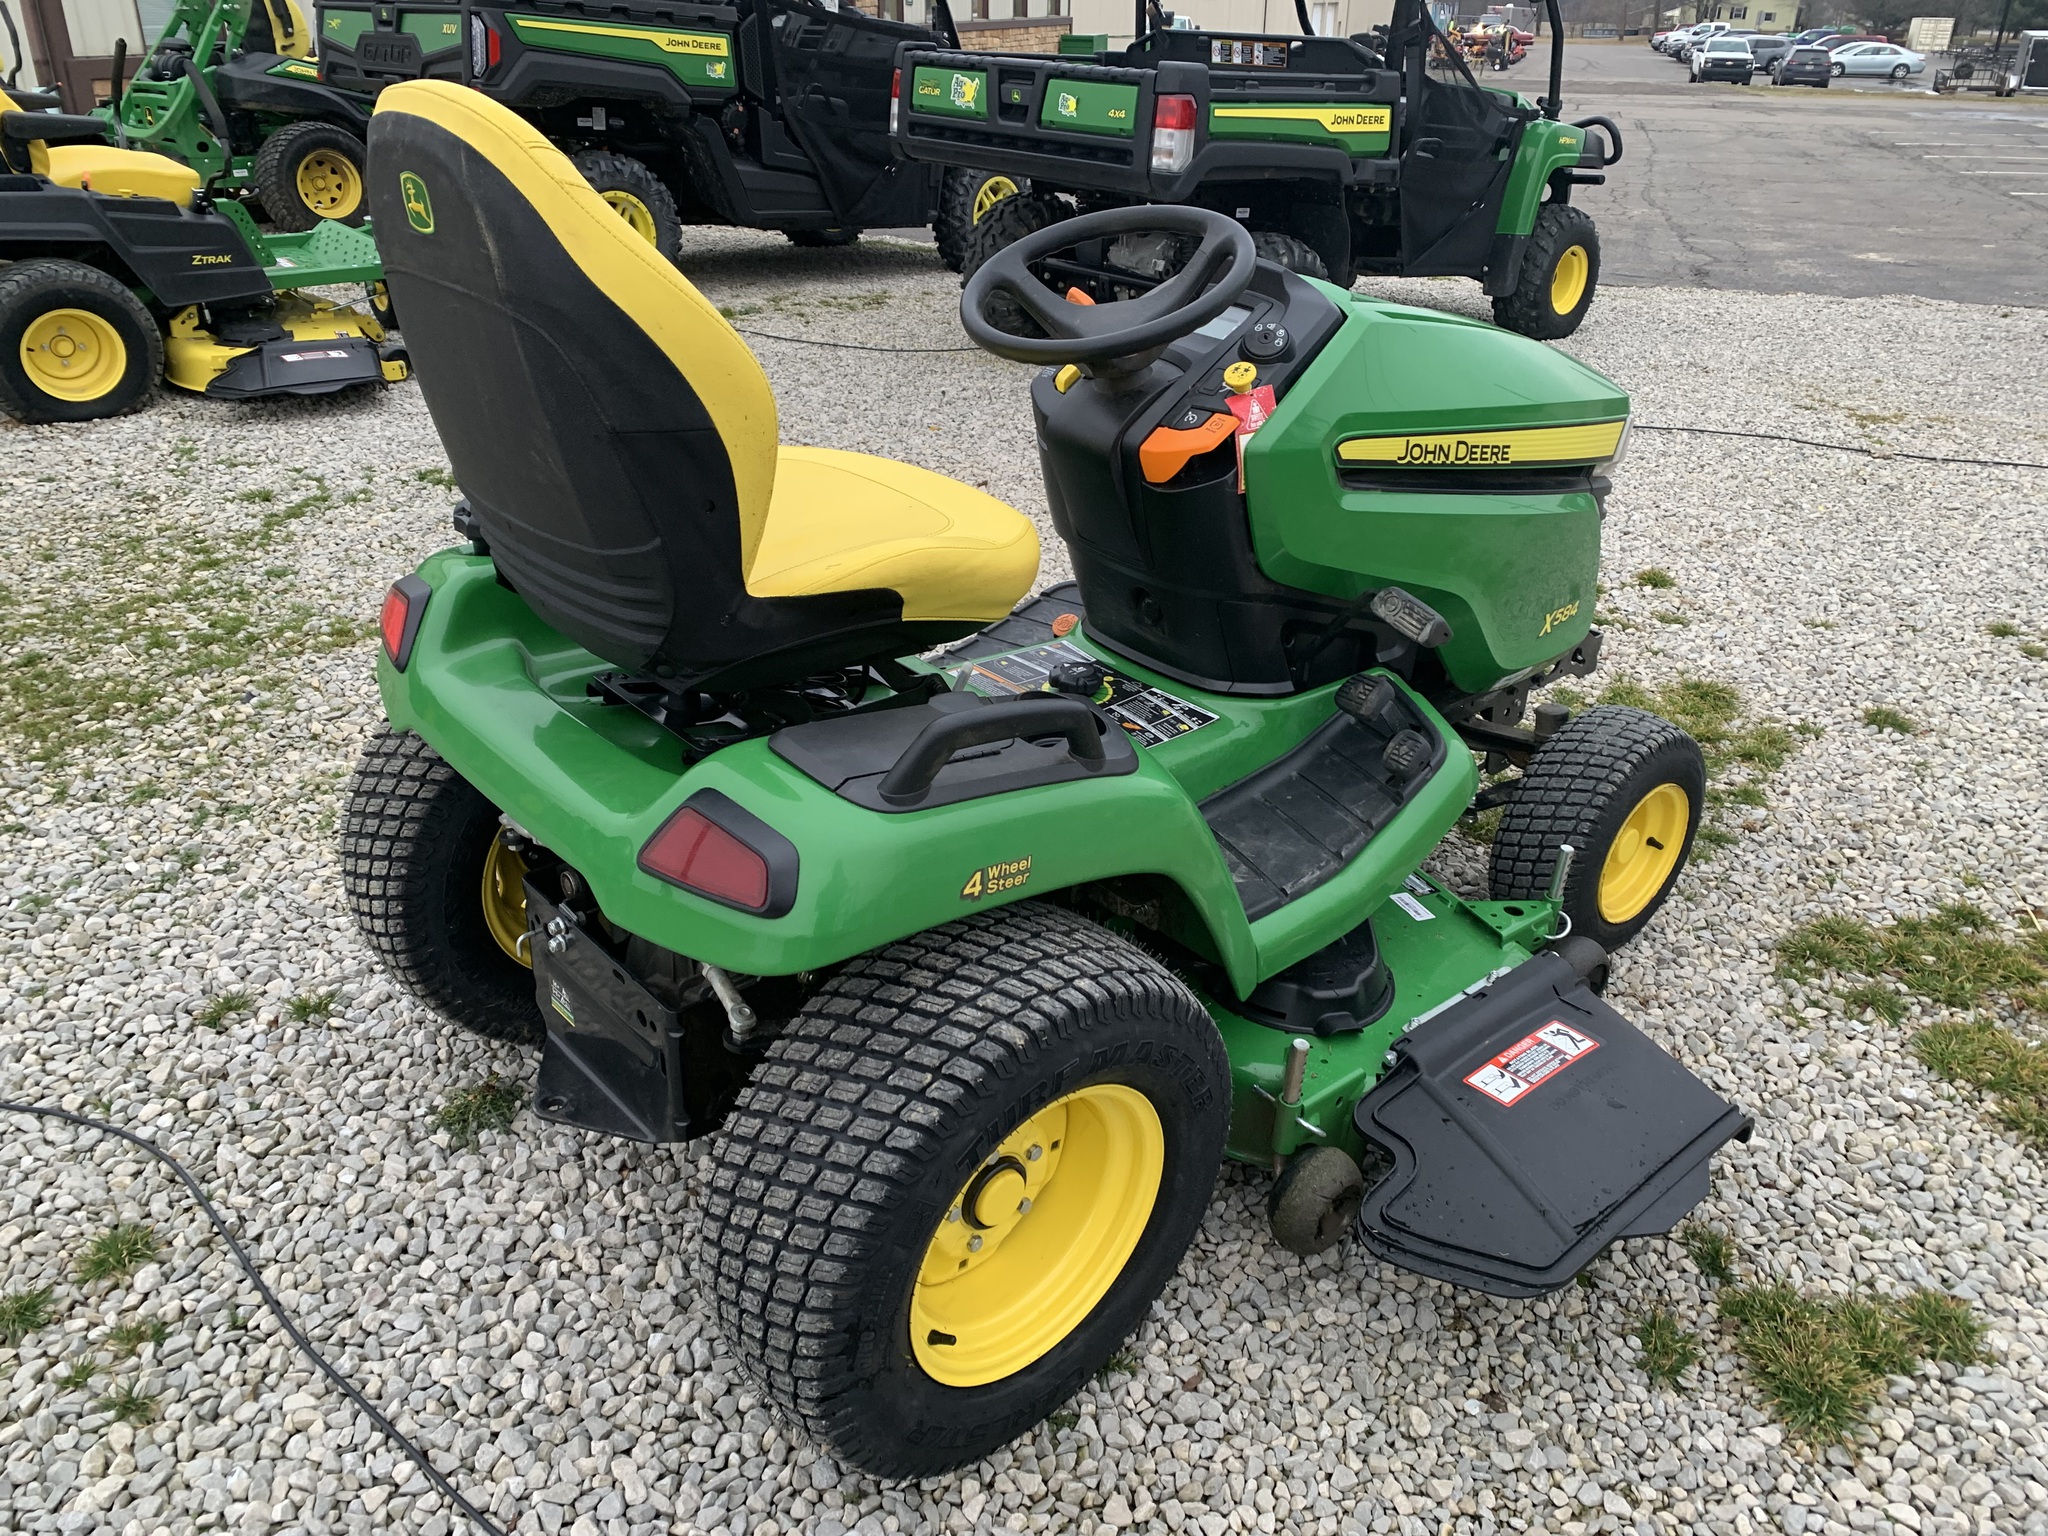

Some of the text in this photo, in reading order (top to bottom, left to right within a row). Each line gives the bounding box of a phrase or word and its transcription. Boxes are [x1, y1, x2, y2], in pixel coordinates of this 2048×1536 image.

[441, 23, 458, 35] XUV
[665, 38, 722, 51] JOHN DEERE
[952, 87, 966, 99] Pro
[1331, 113, 1385, 125] JOHN DEERE
[191, 254, 232, 265] ZTRAK
[1397, 439, 1511, 462] JOHN DEERE
[1538, 600, 1580, 637] X584
[962, 855, 1032, 897] 4 Wheel
[986, 872, 1030, 894] Steer
[1503, 1038, 1535, 1059] DANGER
[954, 1039, 1214, 1172] TURF MASTER
